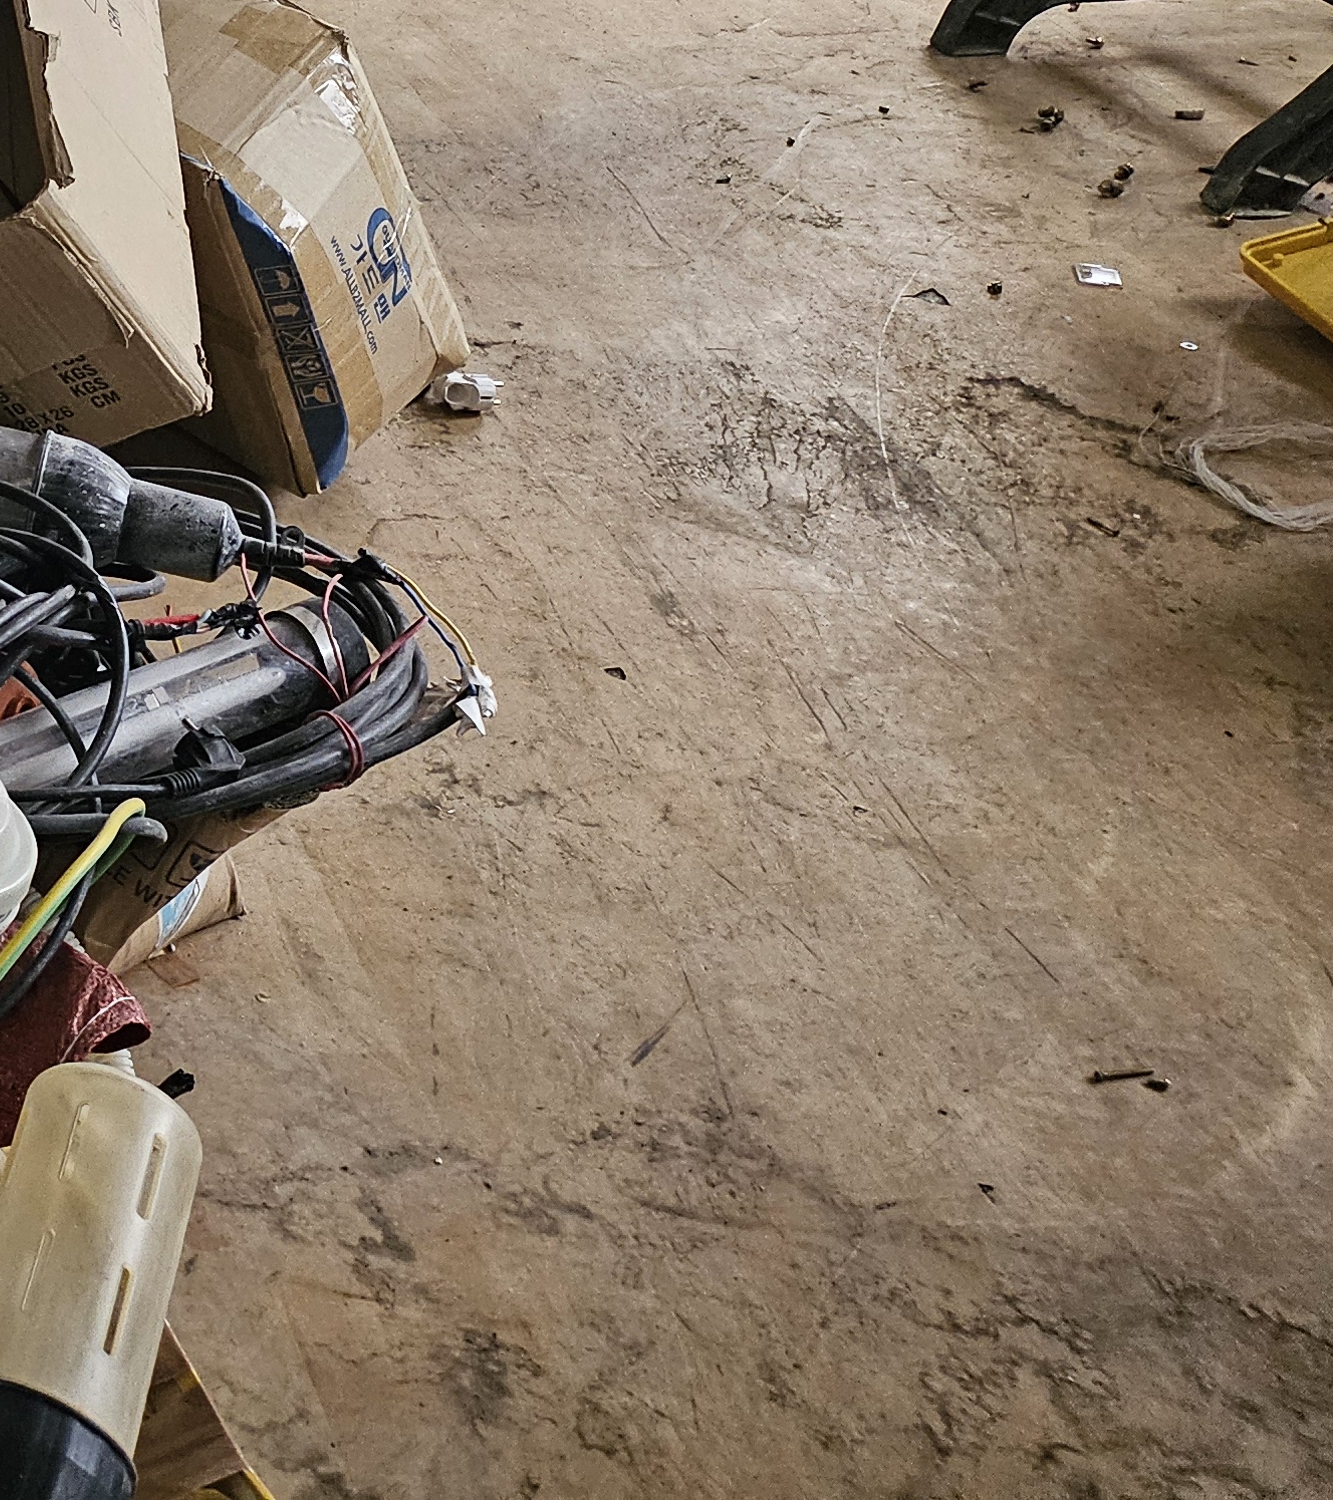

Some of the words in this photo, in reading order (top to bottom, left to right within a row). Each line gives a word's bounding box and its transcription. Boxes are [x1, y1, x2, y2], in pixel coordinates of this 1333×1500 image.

[350, 234, 391, 324] 가드맨
[58, 363, 99, 385] KGS
[69, 376, 111, 398] KGS
[90, 389, 122, 409] CM
